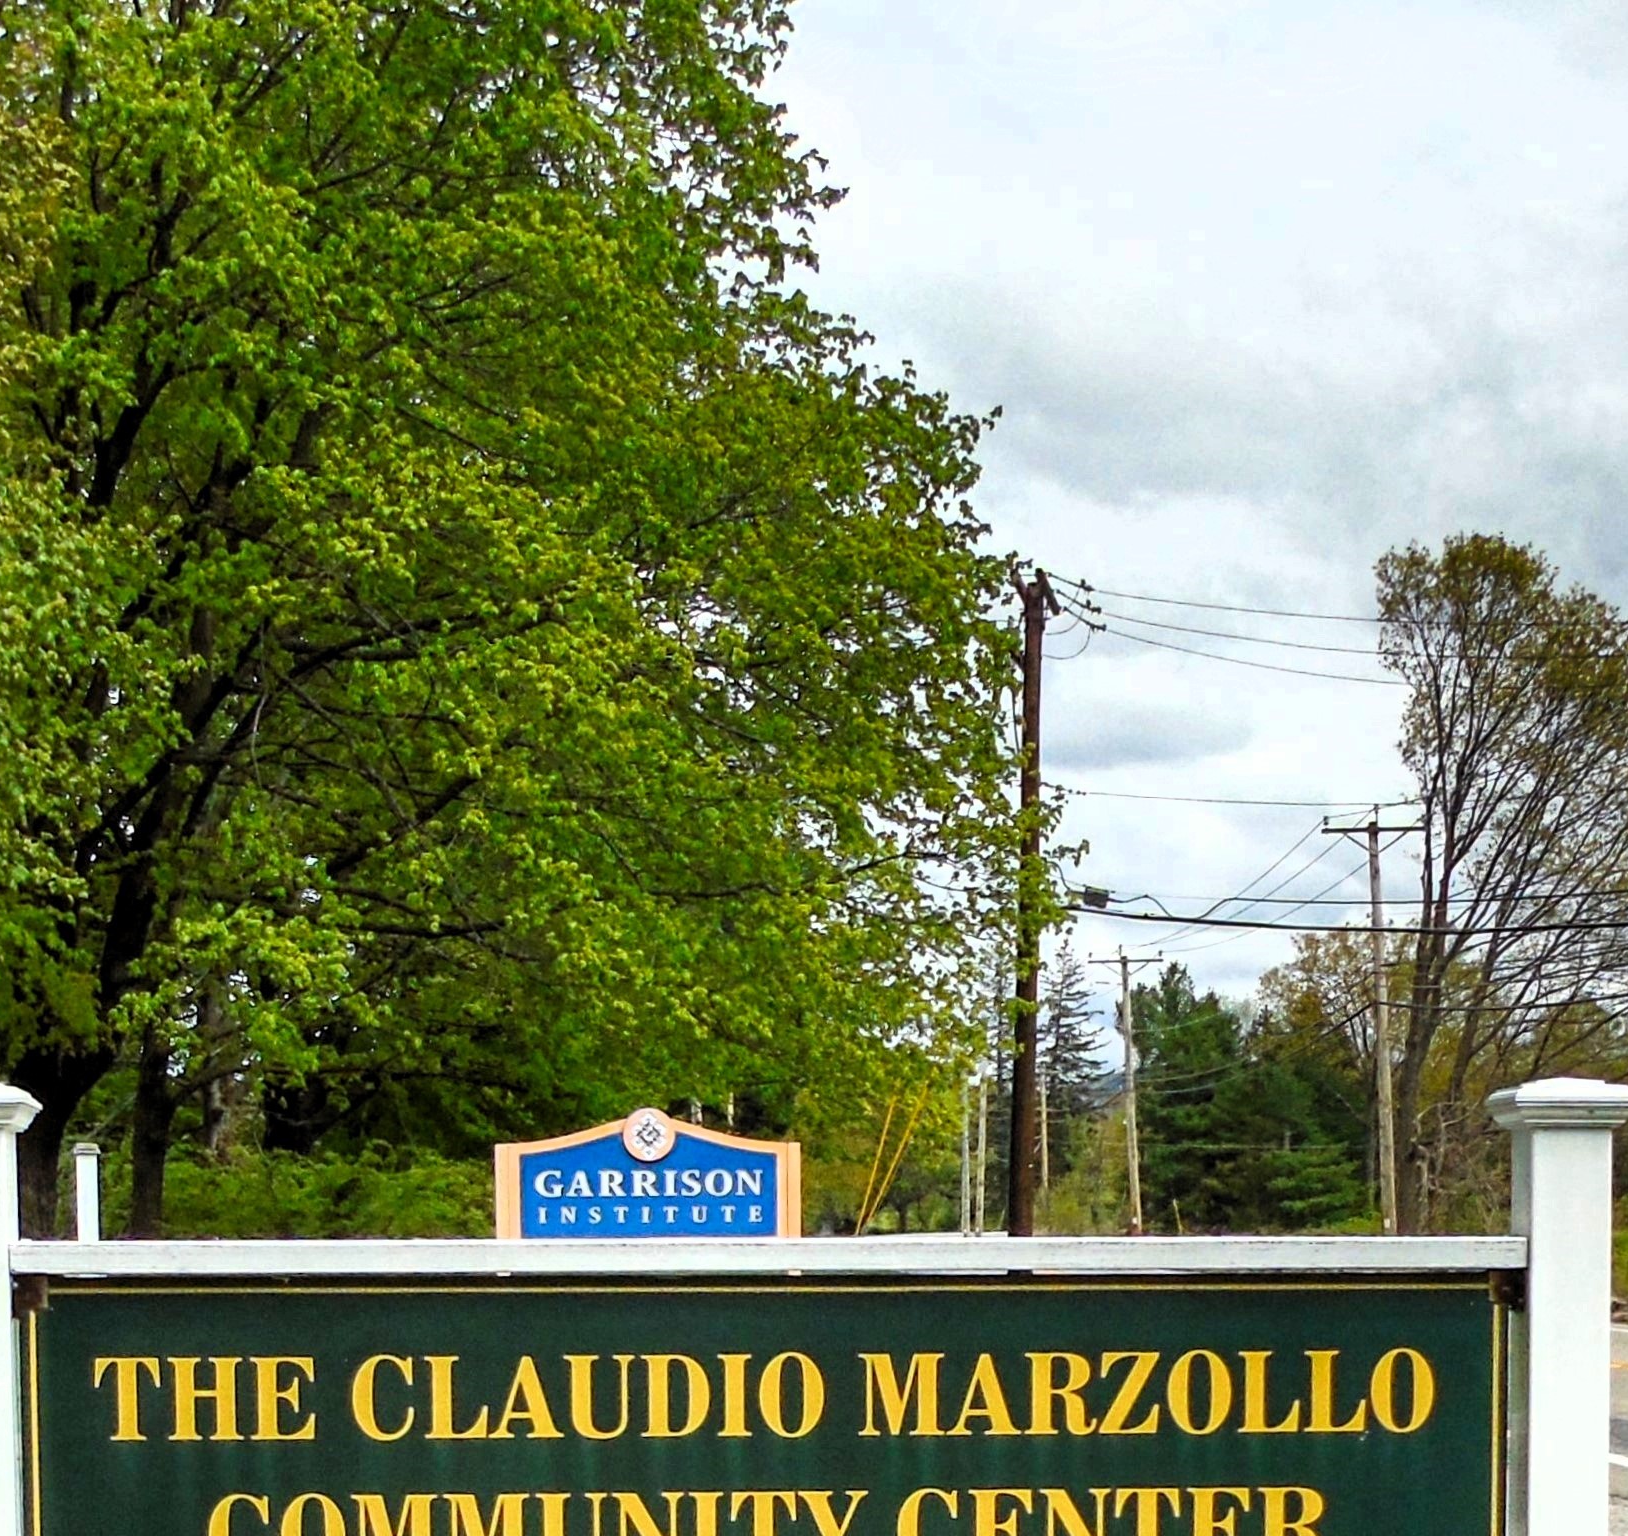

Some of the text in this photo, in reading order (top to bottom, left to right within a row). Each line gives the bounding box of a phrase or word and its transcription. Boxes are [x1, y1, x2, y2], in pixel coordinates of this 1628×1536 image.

[534, 1168, 763, 1198] GARRISON
[538, 1206, 763, 1225] INSTITUTE
[93, 1347, 1436, 1442] THE CLAUDIO MARZOLLO
